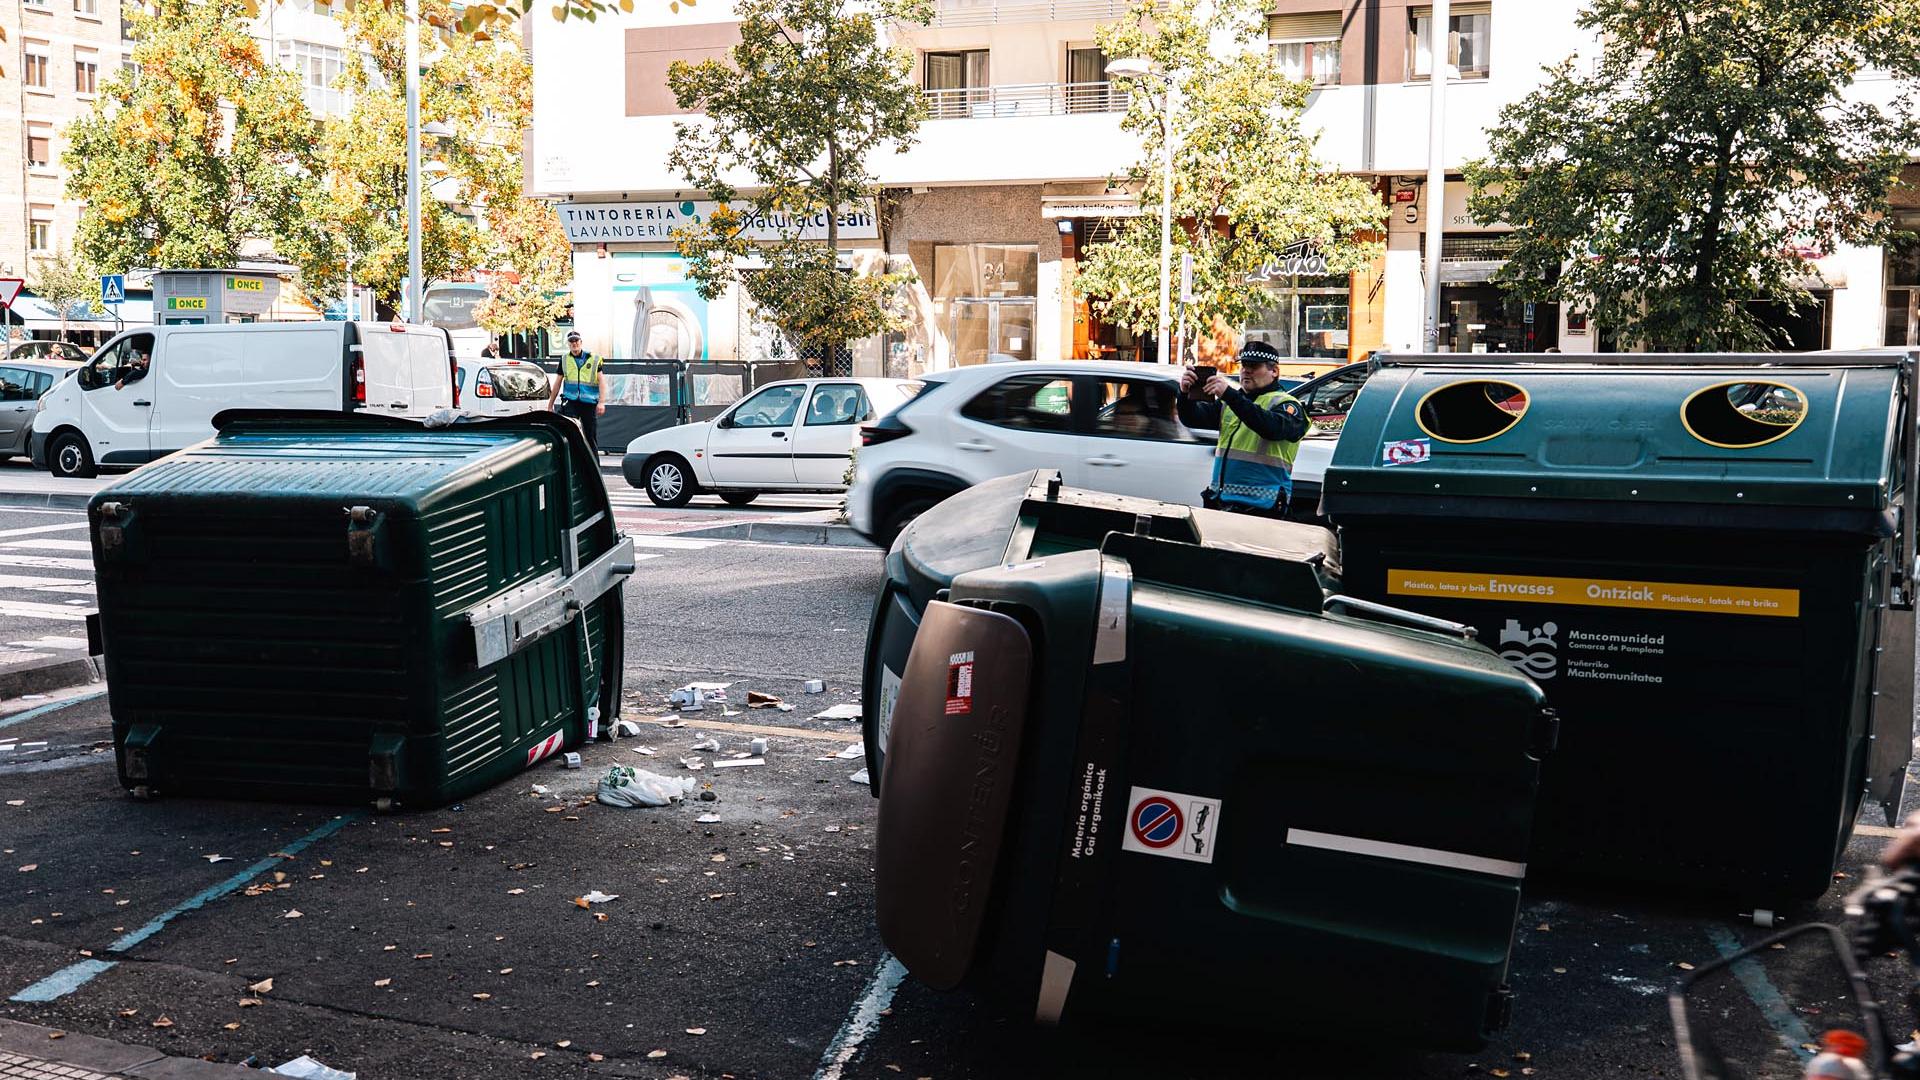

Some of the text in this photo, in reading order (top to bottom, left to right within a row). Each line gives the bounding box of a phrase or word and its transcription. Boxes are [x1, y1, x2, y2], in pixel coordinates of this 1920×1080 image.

[567, 206, 676, 221] TINTORERÍA
[1453, 215, 1472, 225] SIST
[570, 223, 674, 238] LAVANDERÍA
[983, 262, 1006, 280] 34
[237, 280, 261, 289] ONCE
[179, 299, 204, 309] ONCE
[1439, 582, 1459, 591] latas
[1461, 585, 1467, 593] y
[1469, 583, 1485, 593] brik
[1489, 579, 1554, 596] Envases
[1586, 583, 1654, 601] Ontziak
[1709, 596, 1732, 606] latak
[1735, 598, 1750, 608] eta
[1753, 599, 1779, 609] brika
[1568, 629, 1665, 645] Mancomunidad
[1568, 641, 1664, 655] Comarca de Pamplona
[1567, 658, 1609, 669] Iruñerriko
[1567, 667, 1663, 683] Mankomunitatea
[1071, 762, 1095, 858] Materia orgánica
[1084, 768, 1107, 857] Gai organikoak
